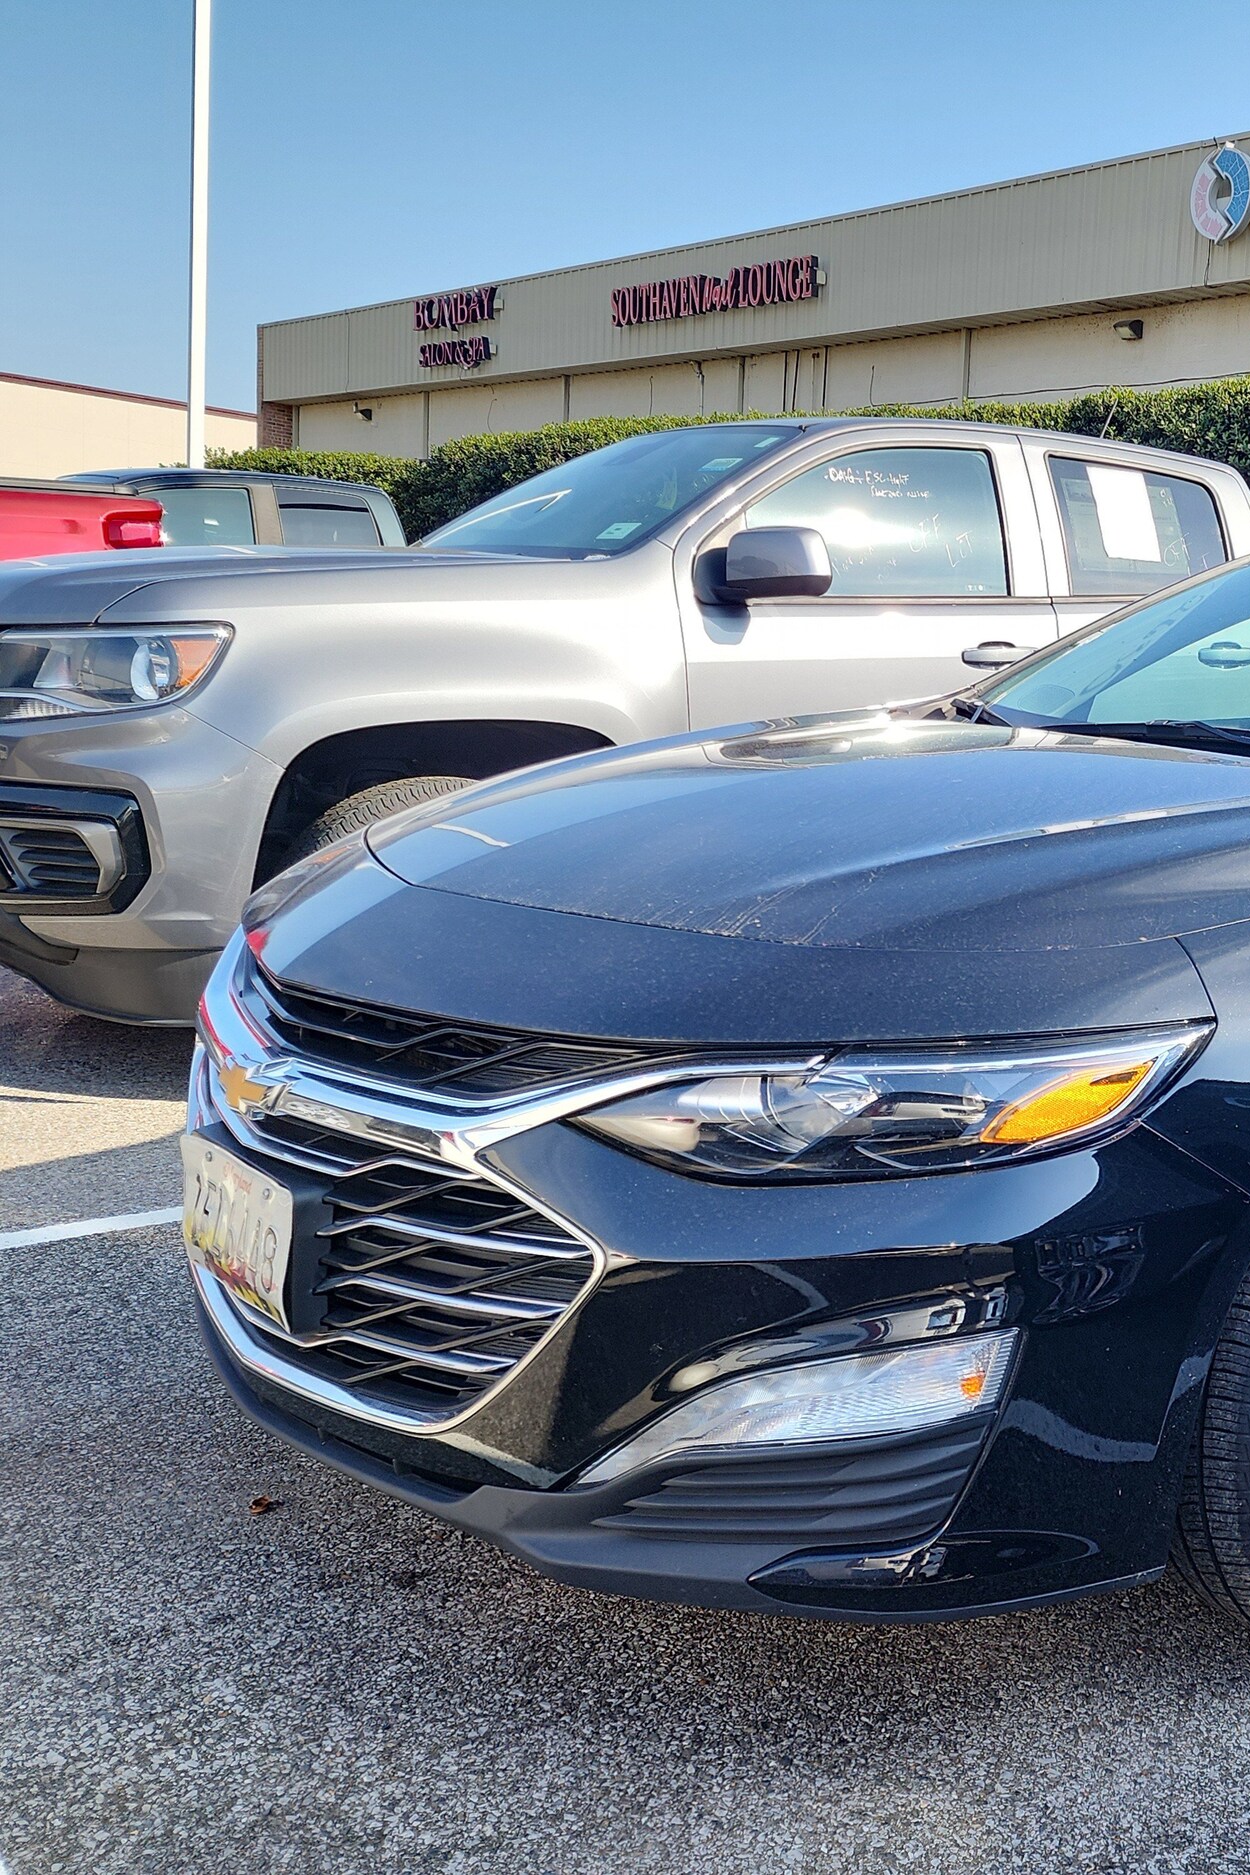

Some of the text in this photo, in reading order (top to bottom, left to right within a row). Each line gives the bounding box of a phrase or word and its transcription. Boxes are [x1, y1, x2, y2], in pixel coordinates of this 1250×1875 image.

[413, 286, 499, 333] BOMBAY
[610, 254, 819, 328] SOUTHAVEN Nail LOUNGE
[419, 339, 457, 368] SALON
[467, 335, 493, 364] SPA
